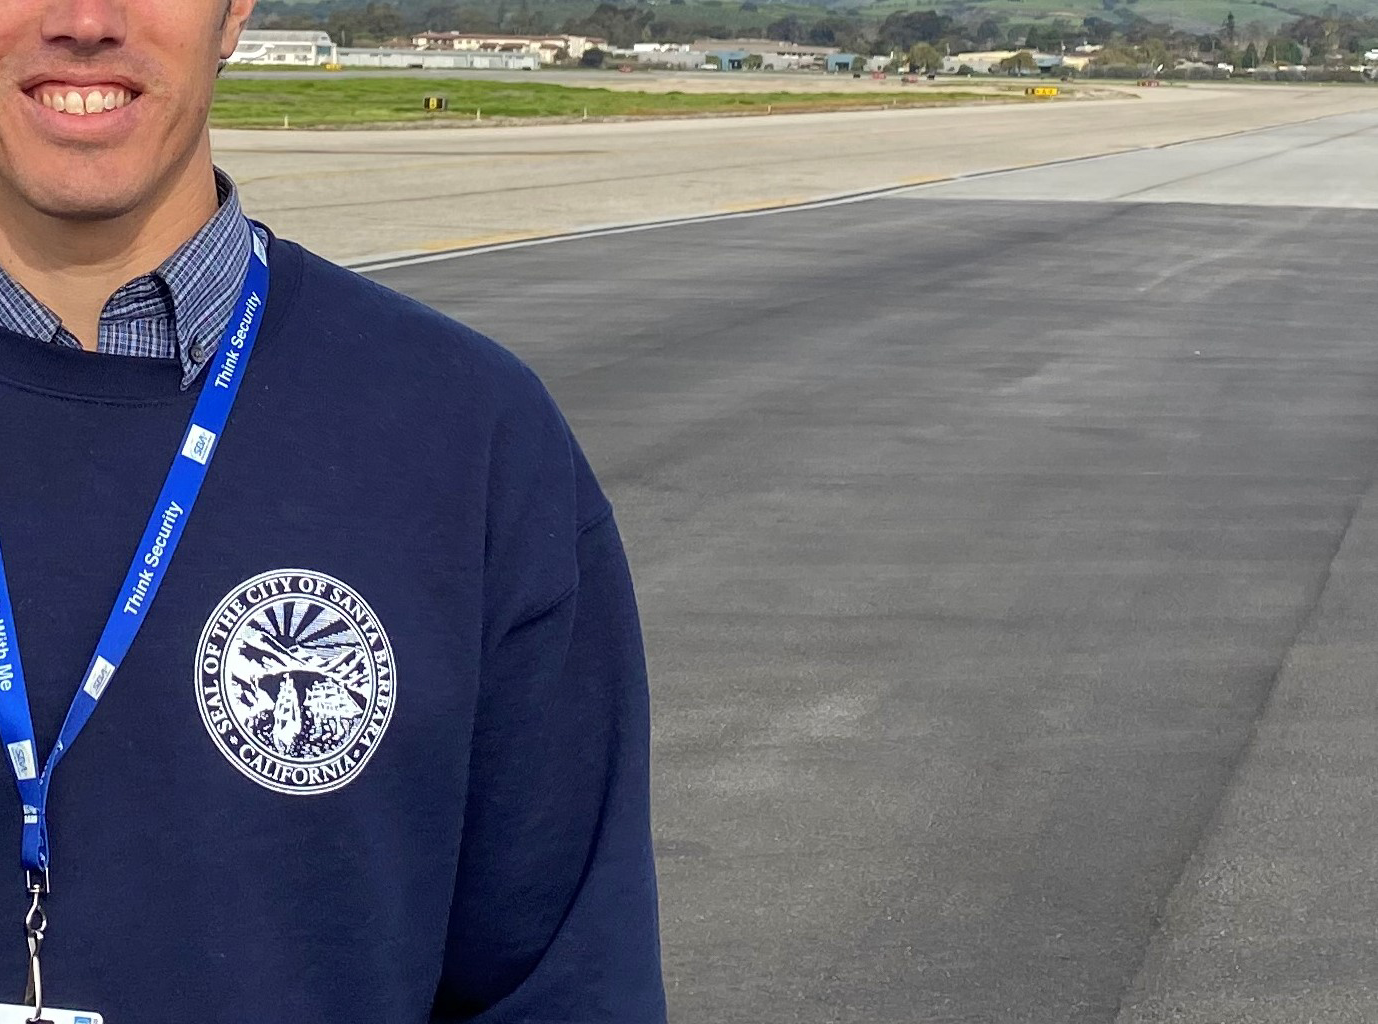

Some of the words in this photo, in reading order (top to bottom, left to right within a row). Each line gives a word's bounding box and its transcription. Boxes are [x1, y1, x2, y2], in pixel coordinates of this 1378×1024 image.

[214, 349, 240, 389] Think
[231, 291, 262, 349] Security
[123, 568, 154, 615] Think
[144, 500, 184, 568] Security
[246, 577, 293, 604] CITY
[298, 577, 328, 596] OF
[212, 598, 247, 645] THE
[330, 587, 381, 647] SANTA
[203, 642, 222, 674] OF
[204, 679, 233, 734] SEAL
[359, 650, 392, 754] BARBARA
[238, 744, 358, 785] CALIFORNIA
